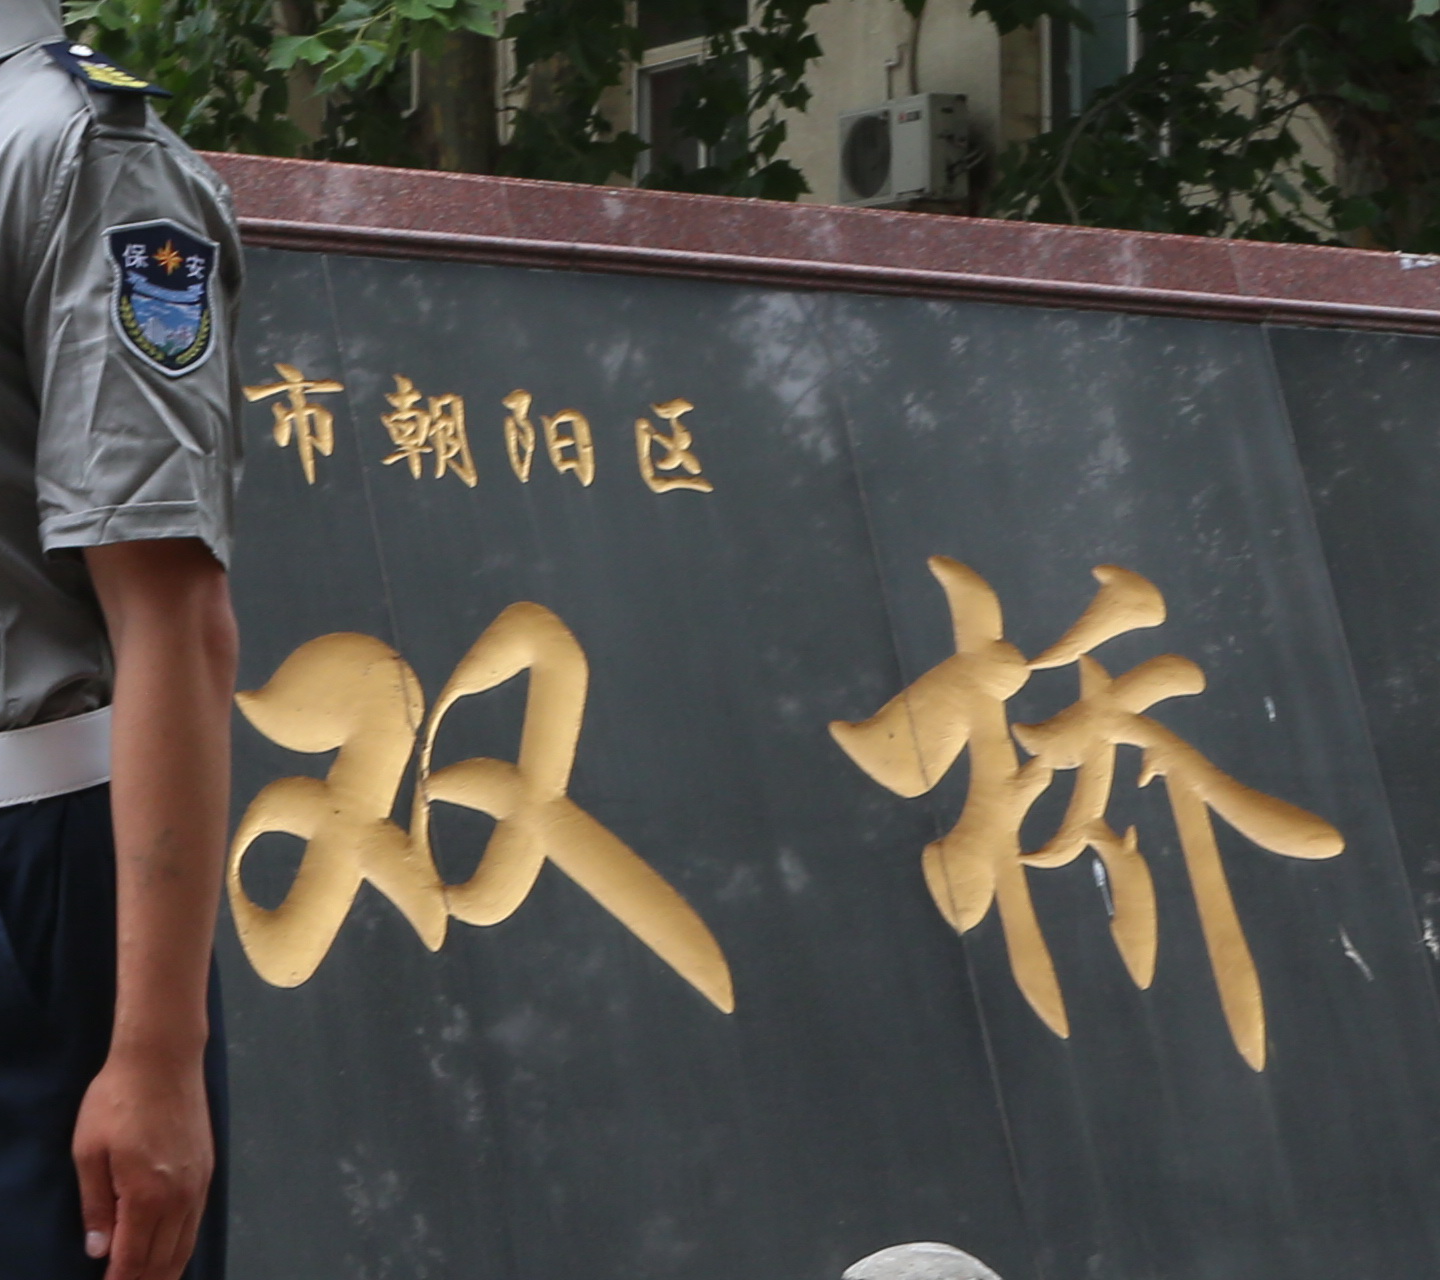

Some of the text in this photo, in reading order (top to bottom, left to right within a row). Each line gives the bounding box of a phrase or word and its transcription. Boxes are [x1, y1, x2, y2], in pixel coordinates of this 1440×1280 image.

[122, 243, 206, 280] 保安
[244, 363, 713, 494] 市朝阳区
